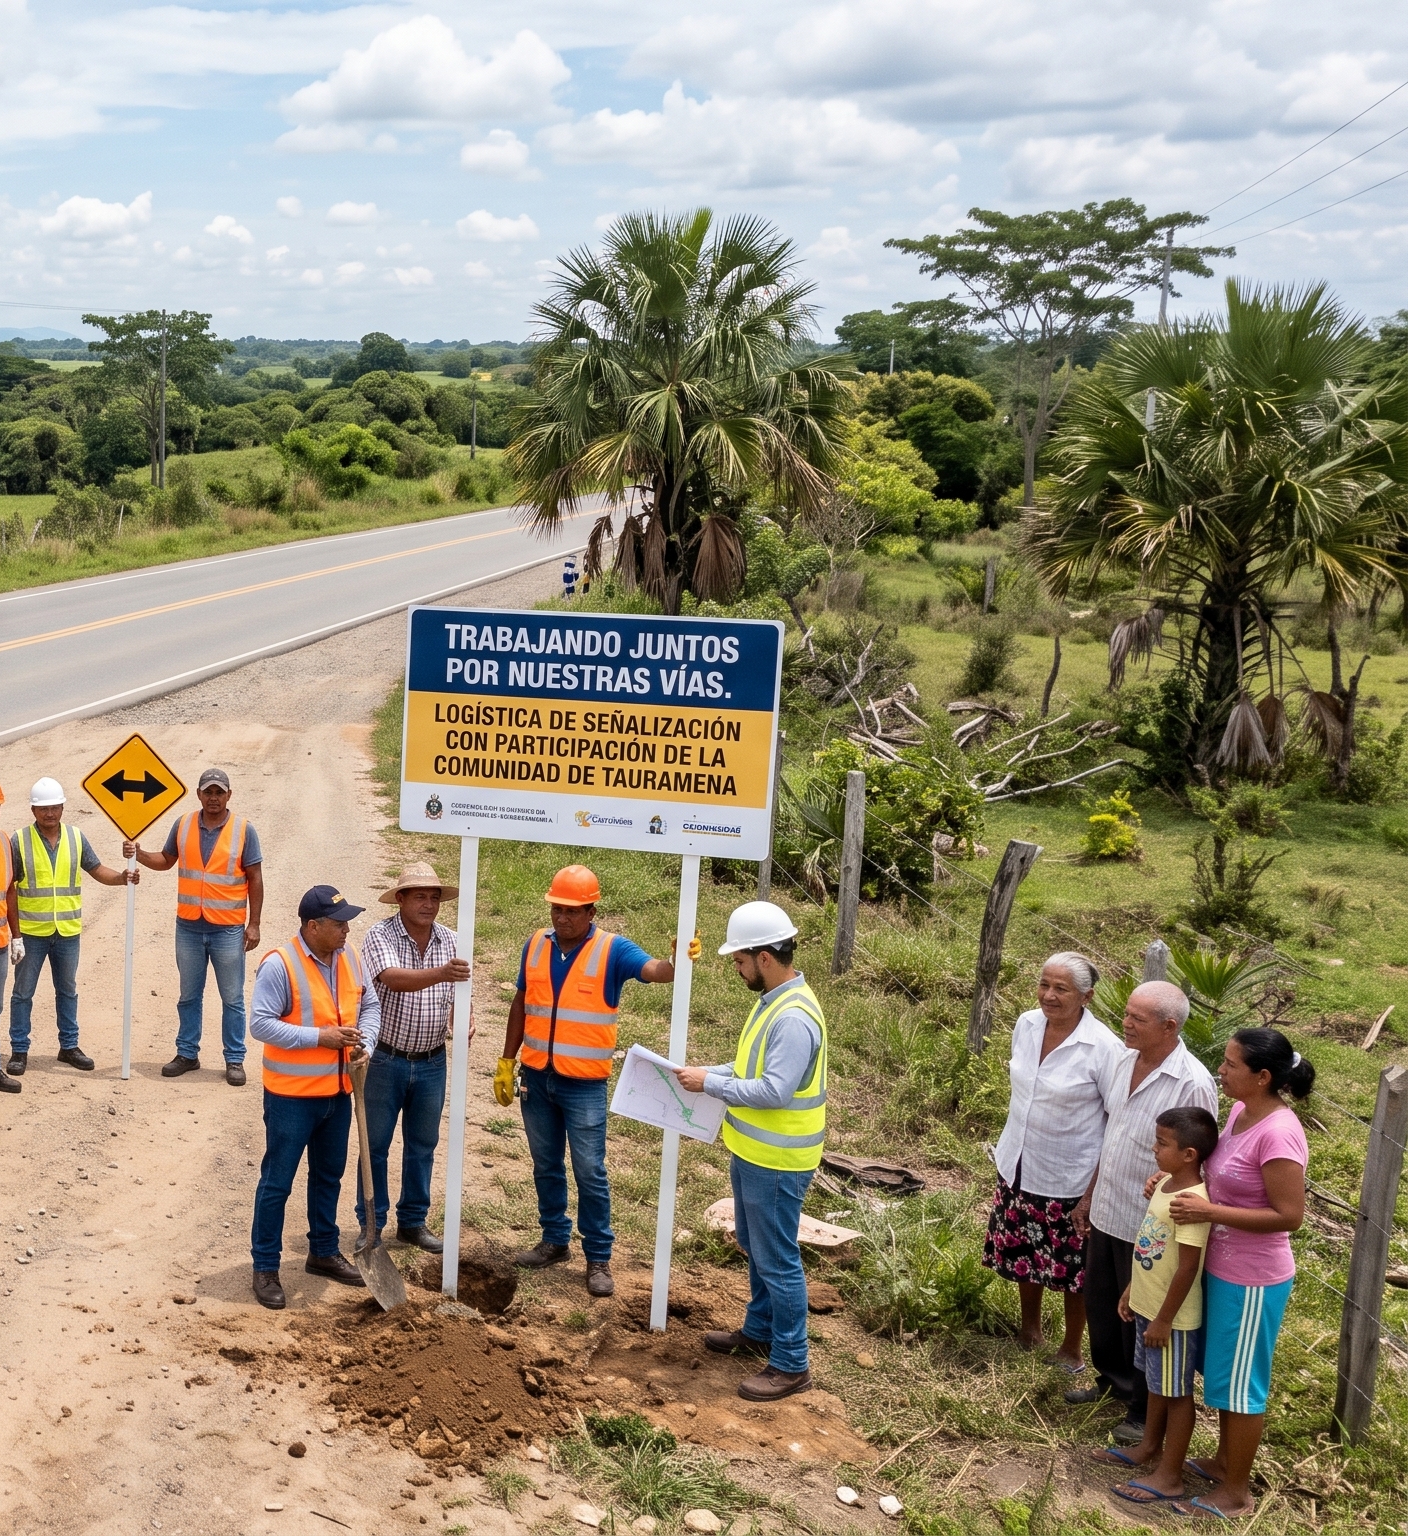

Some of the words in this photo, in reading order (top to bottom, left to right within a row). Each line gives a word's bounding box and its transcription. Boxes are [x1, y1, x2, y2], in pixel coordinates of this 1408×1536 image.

[444, 624, 621, 658] TRABAJANDO
[629, 632, 740, 664] JUNTOS
[446, 657, 499, 686] POR
[508, 661, 651, 694] NUESTRAS
[659, 664, 732, 699] VÍAS.
[434, 702, 543, 729] LOGÍSTICA
[549, 710, 577, 732] DE
[582, 710, 741, 742] SEÑALIZACIÓN
[445, 729, 488, 752] CON
[495, 733, 657, 764] PARTICIPACIÓN
[663, 744, 693, 766] DE
[698, 746, 726, 768] LA
[434, 755, 561, 783] COMUNIDAD
[567, 764, 595, 786] DE
[602, 767, 737, 796] TAURAMENA
